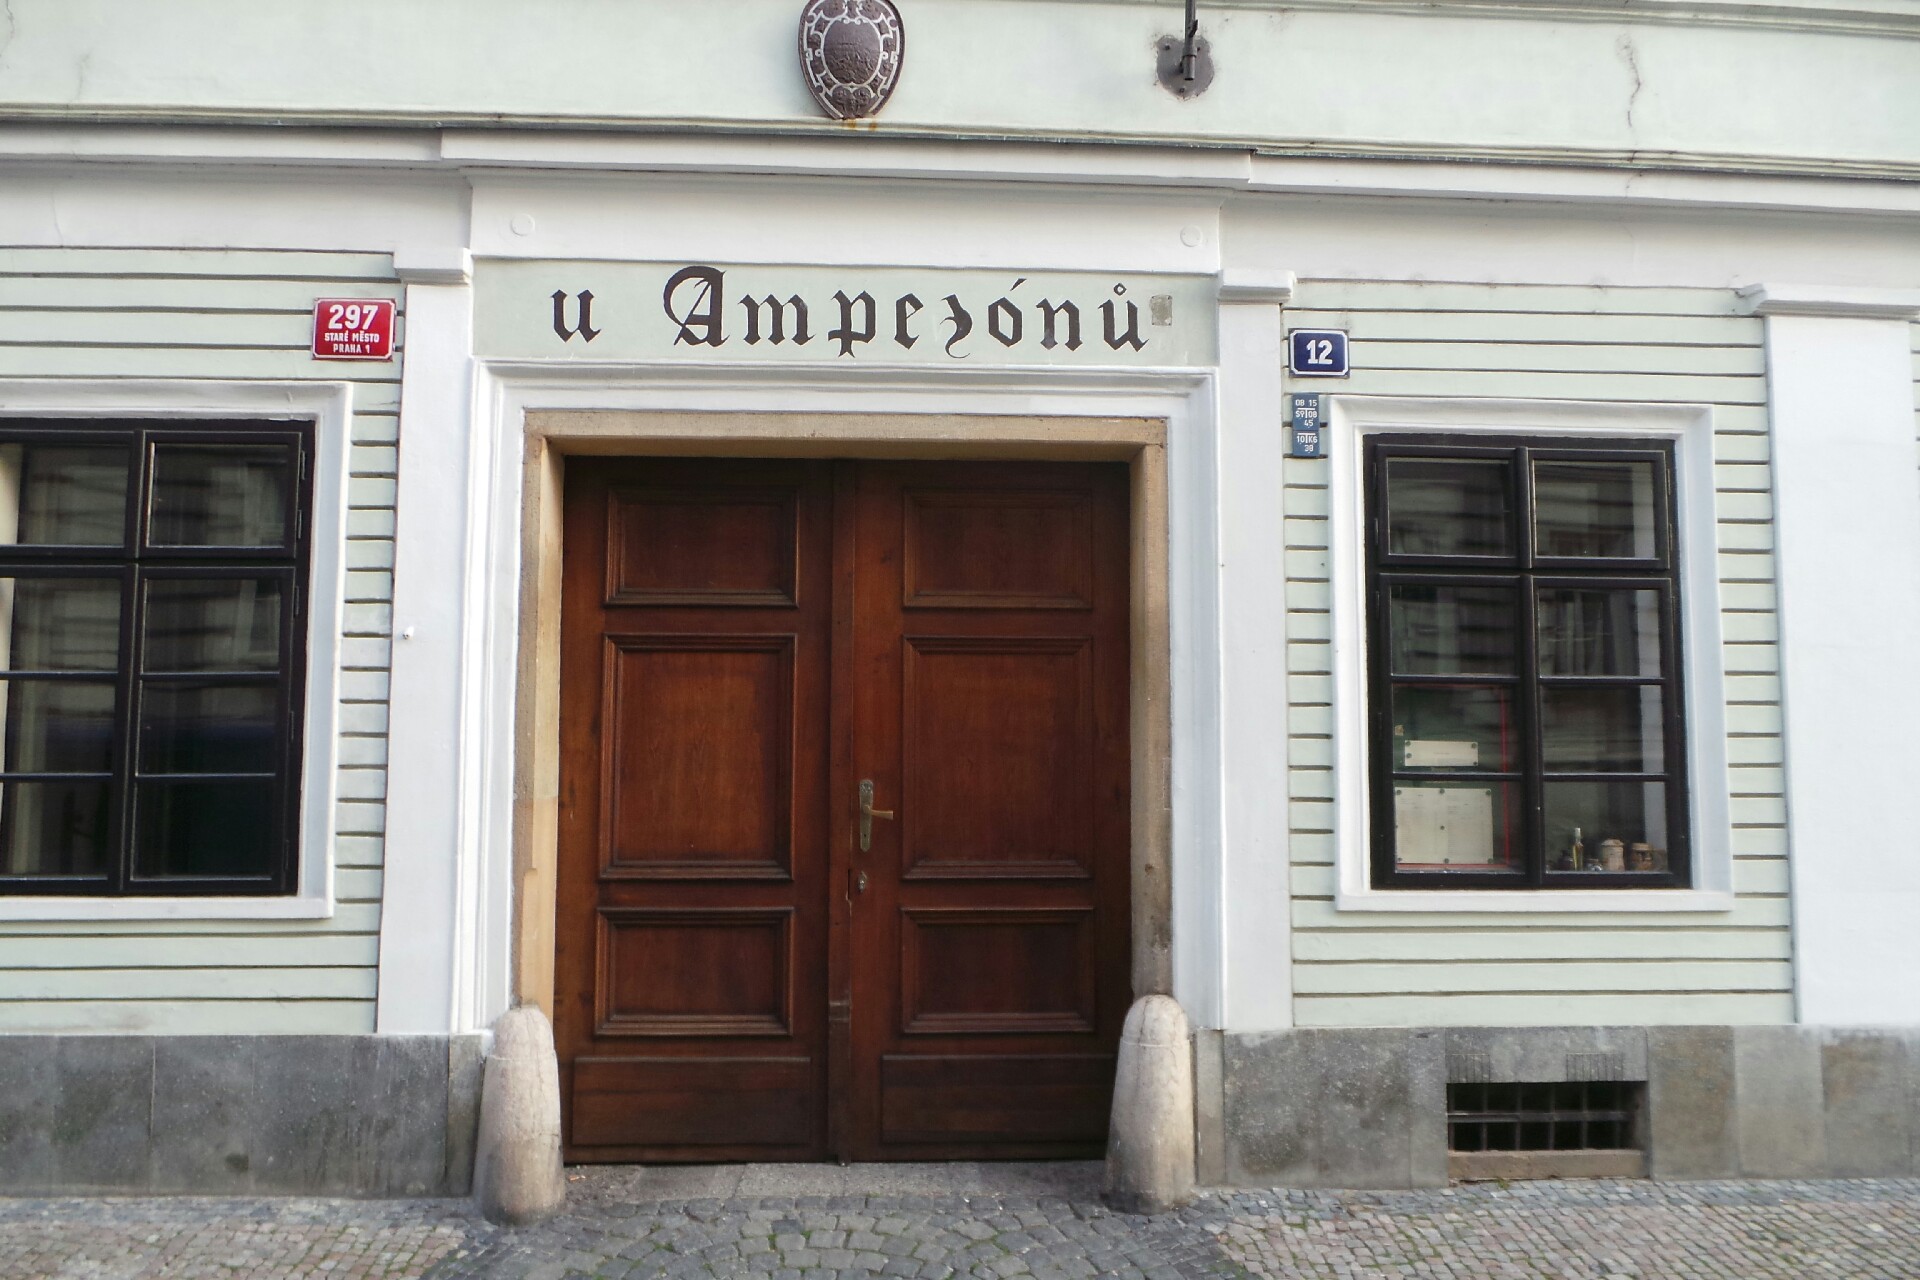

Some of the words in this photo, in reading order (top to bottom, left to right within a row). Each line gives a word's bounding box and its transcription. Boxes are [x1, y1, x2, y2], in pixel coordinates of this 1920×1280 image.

[328, 304, 379, 330] 297
[324, 330, 349, 342] STARÉ
[352, 330, 380, 343] MĚSTO
[333, 343, 362, 354] PRAHA
[365, 344, 370, 354] 1
[1306, 339, 1333, 365] 12
[1309, 399, 1318, 407] 15
